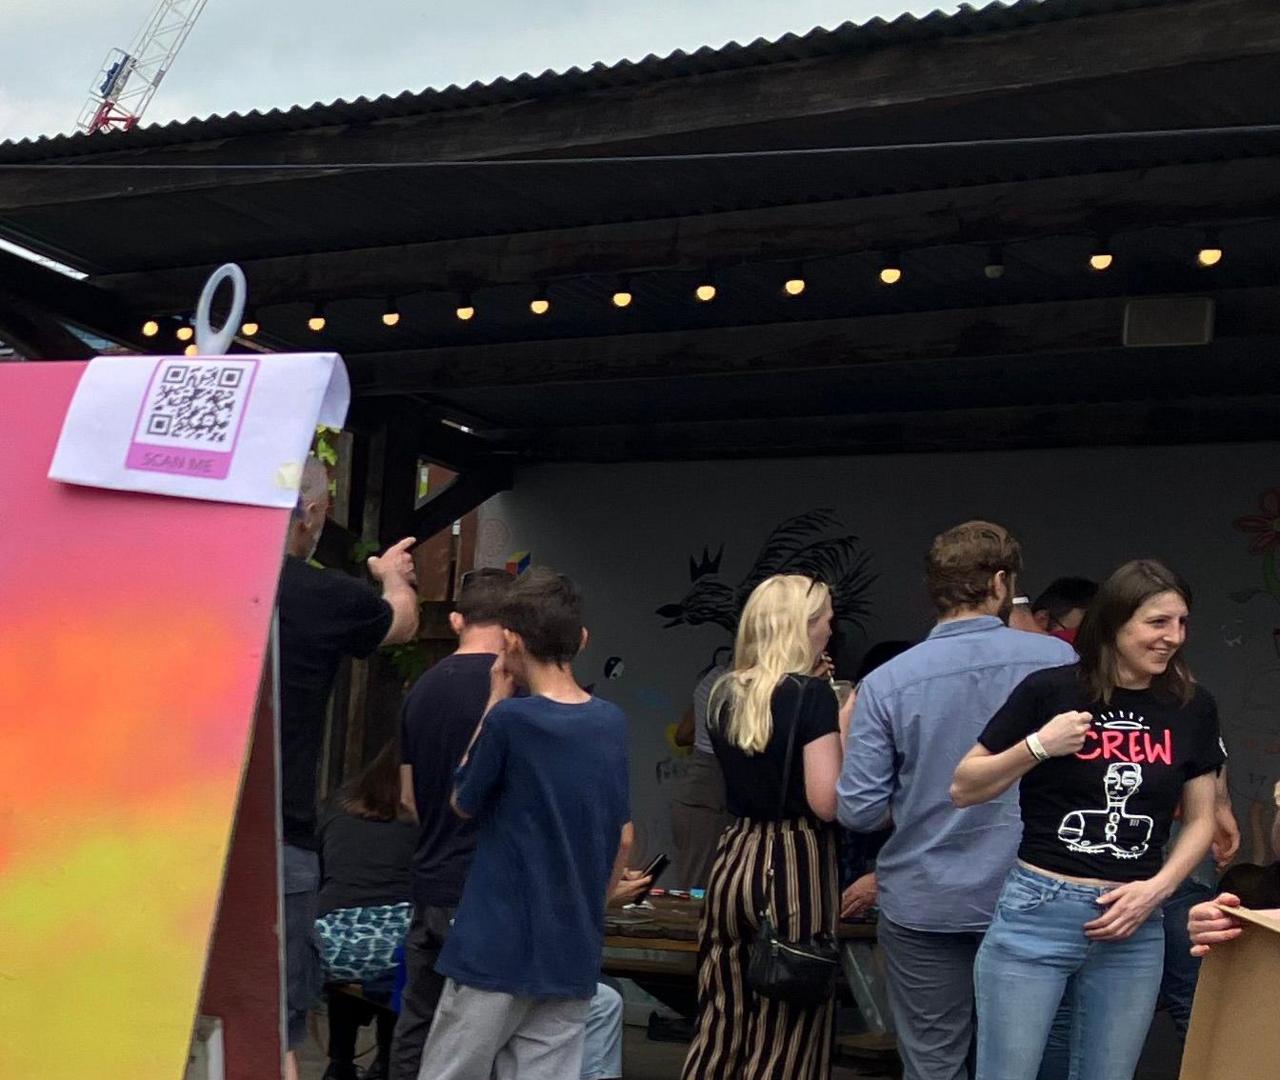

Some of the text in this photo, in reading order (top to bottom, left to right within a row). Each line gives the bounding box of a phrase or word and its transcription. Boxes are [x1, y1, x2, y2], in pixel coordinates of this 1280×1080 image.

[142, 452, 213, 473] SCAN ME
[1074, 729, 1172, 765] CREW
